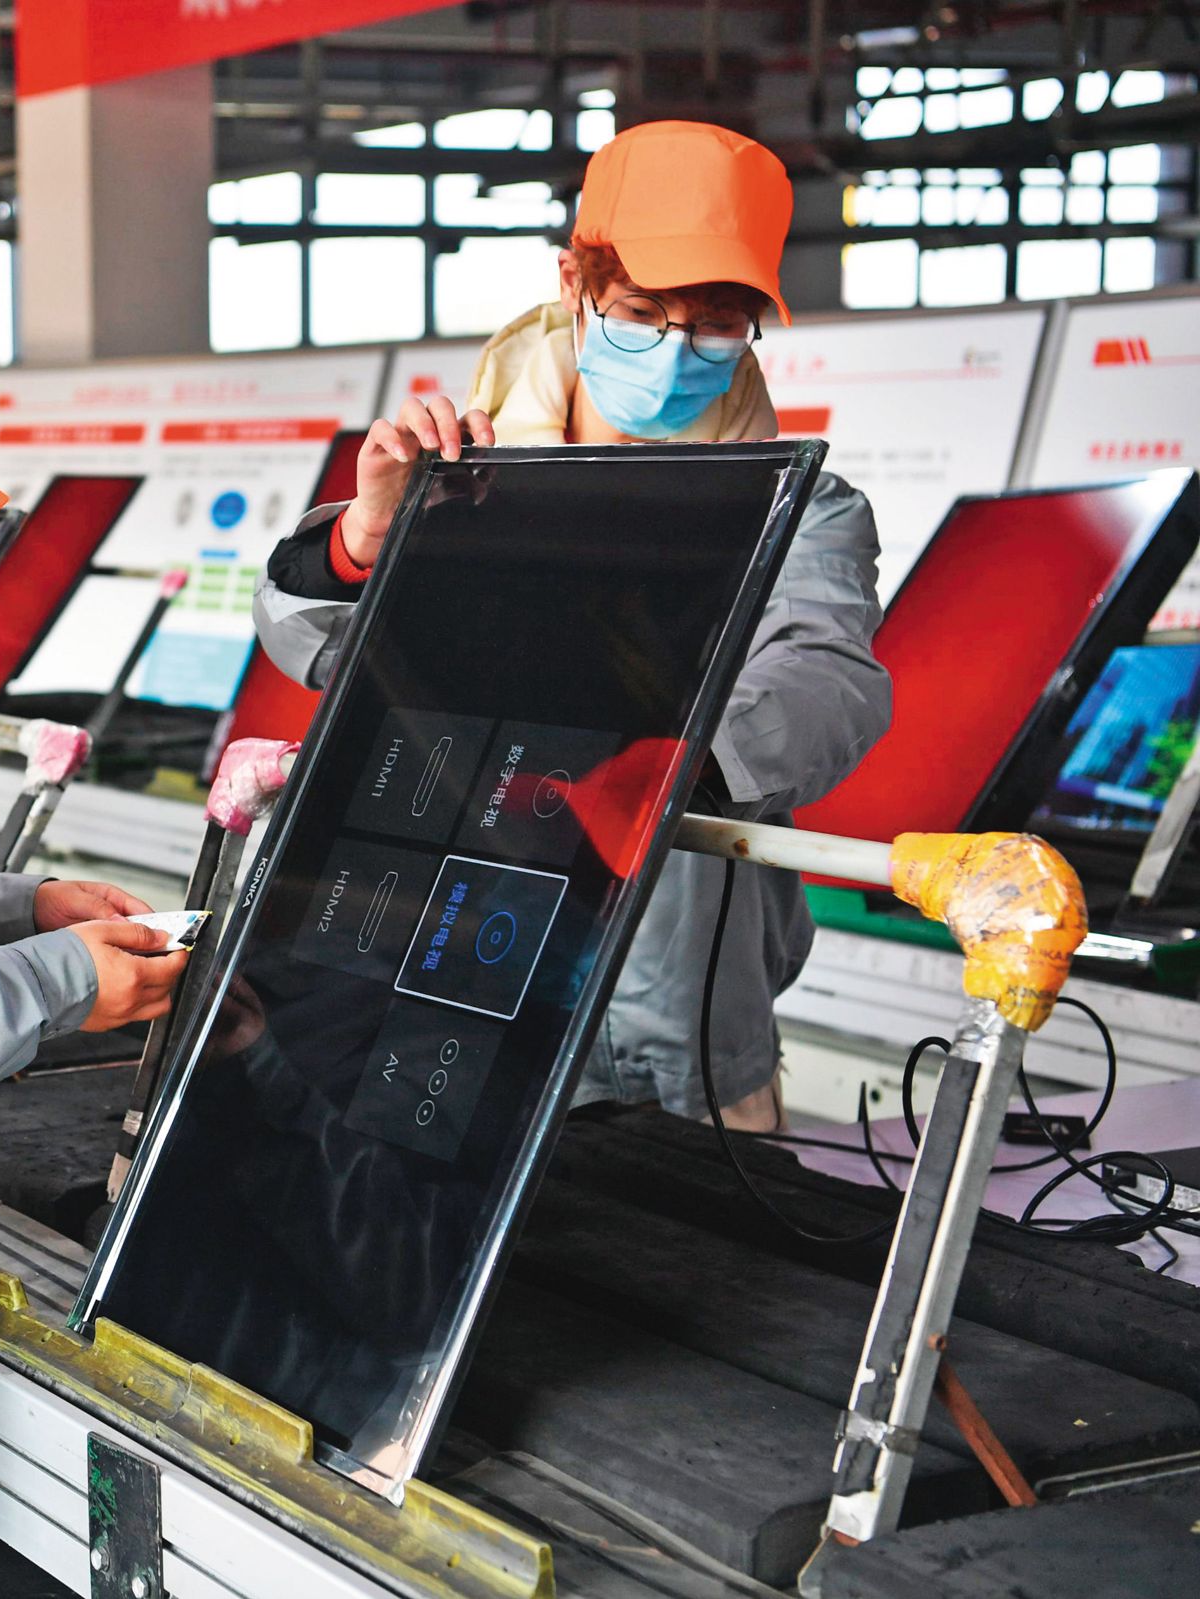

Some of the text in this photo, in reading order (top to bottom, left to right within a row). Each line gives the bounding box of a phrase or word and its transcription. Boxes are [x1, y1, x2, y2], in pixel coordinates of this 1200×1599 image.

[371, 738, 404, 797] HDMI1
[480, 744, 525, 828] 数字电视
[242, 857, 269, 908] KONKA
[316, 870, 351, 932] HDMI2
[421, 882, 468, 971] 模拟电视
[382, 1052, 399, 1082] AV
